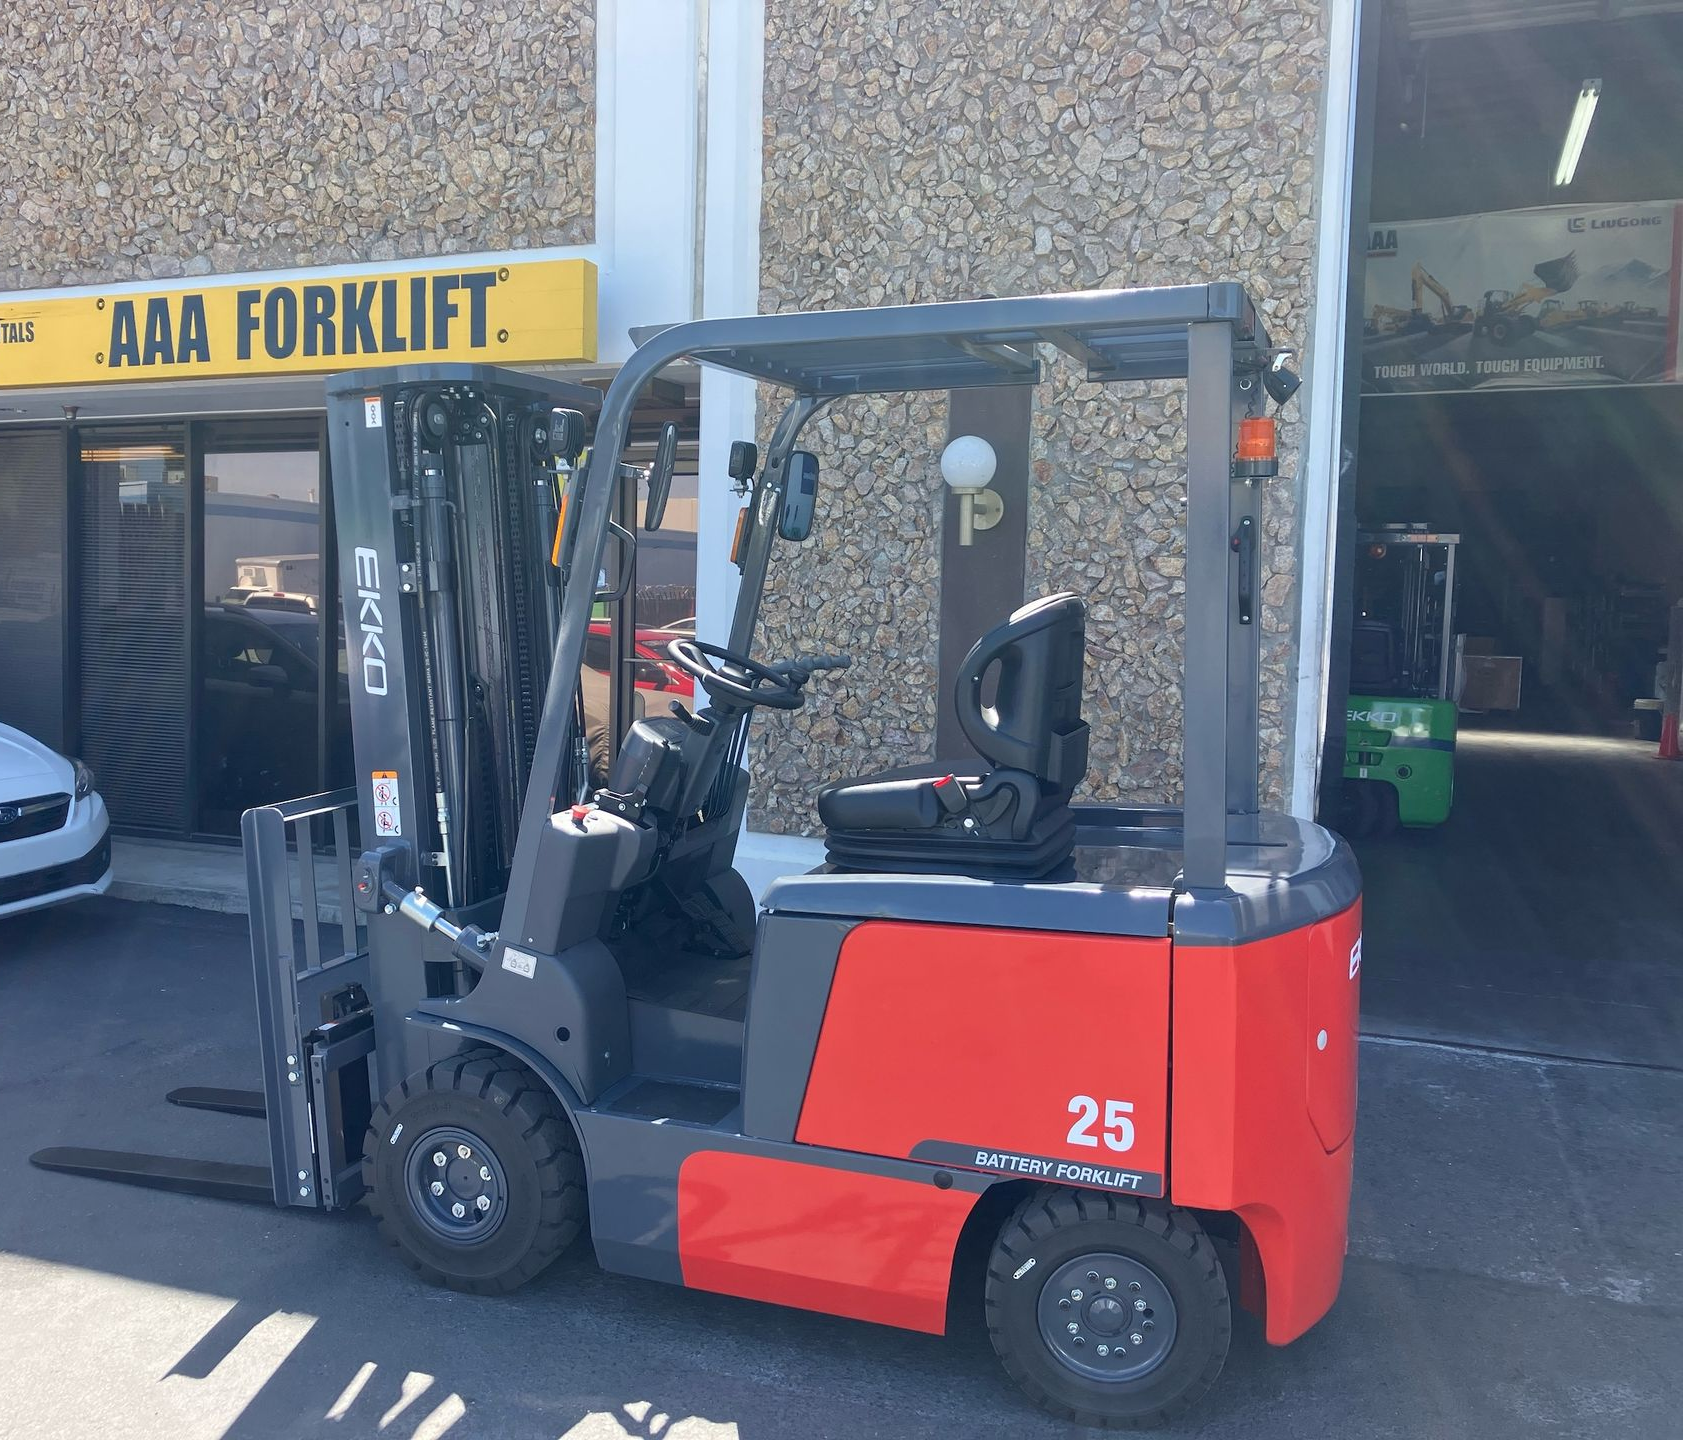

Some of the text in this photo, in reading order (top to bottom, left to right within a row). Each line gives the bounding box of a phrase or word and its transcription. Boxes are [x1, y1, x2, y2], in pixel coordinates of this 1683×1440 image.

[1, 321, 35, 344] TALS
[108, 271, 497, 367] AAA FORKLIFT
[1374, 355, 1605, 379] TOUGH WORLD. TOUGH EQUIPMENT.
[354, 546, 388, 697] EKKO
[1066, 1094, 1135, 1152] 25
[975, 1151, 1142, 1188] BATTERY FORKLIFT
